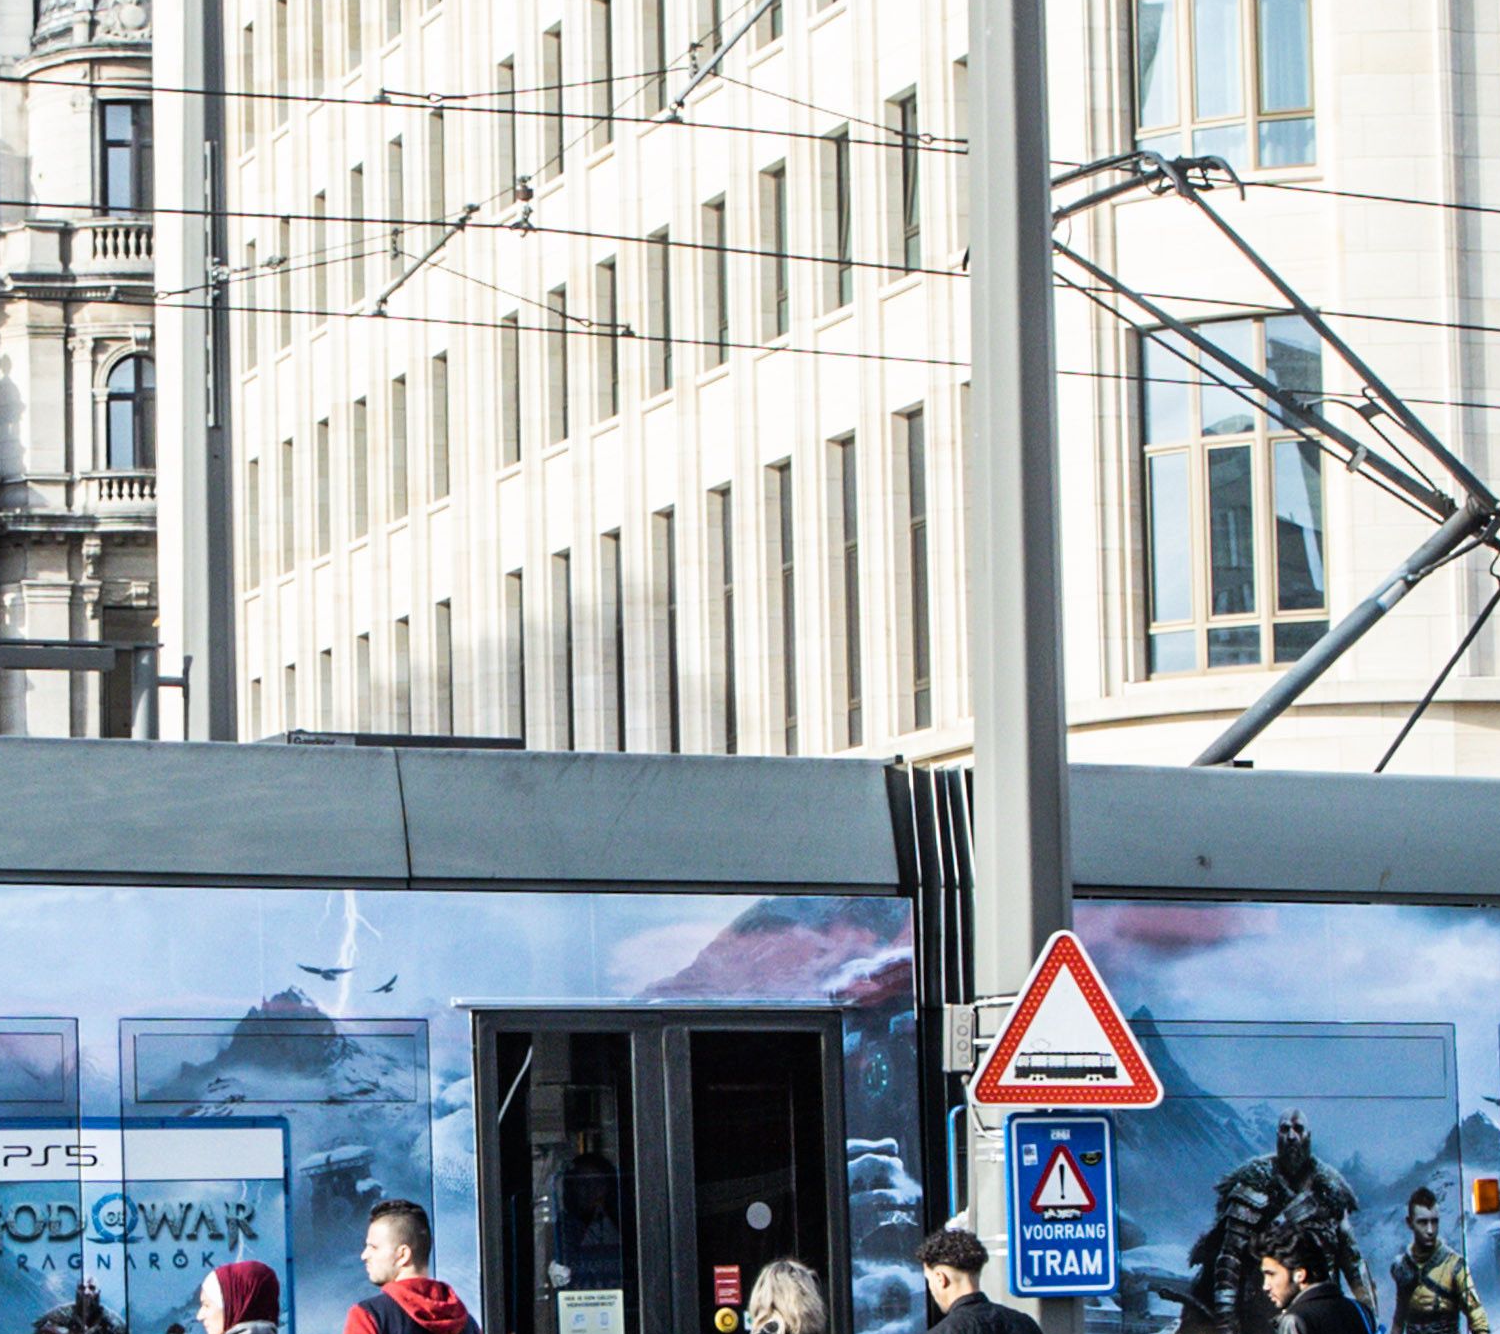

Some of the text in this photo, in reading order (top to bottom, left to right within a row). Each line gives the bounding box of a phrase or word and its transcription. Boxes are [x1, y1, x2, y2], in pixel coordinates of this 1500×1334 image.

[3, 1144, 99, 1168] PS5
[137, 1200, 259, 1252] WAR
[1022, 1223, 1106, 1240] VOORRANG
[1028, 1249, 1103, 1277] TRAM
